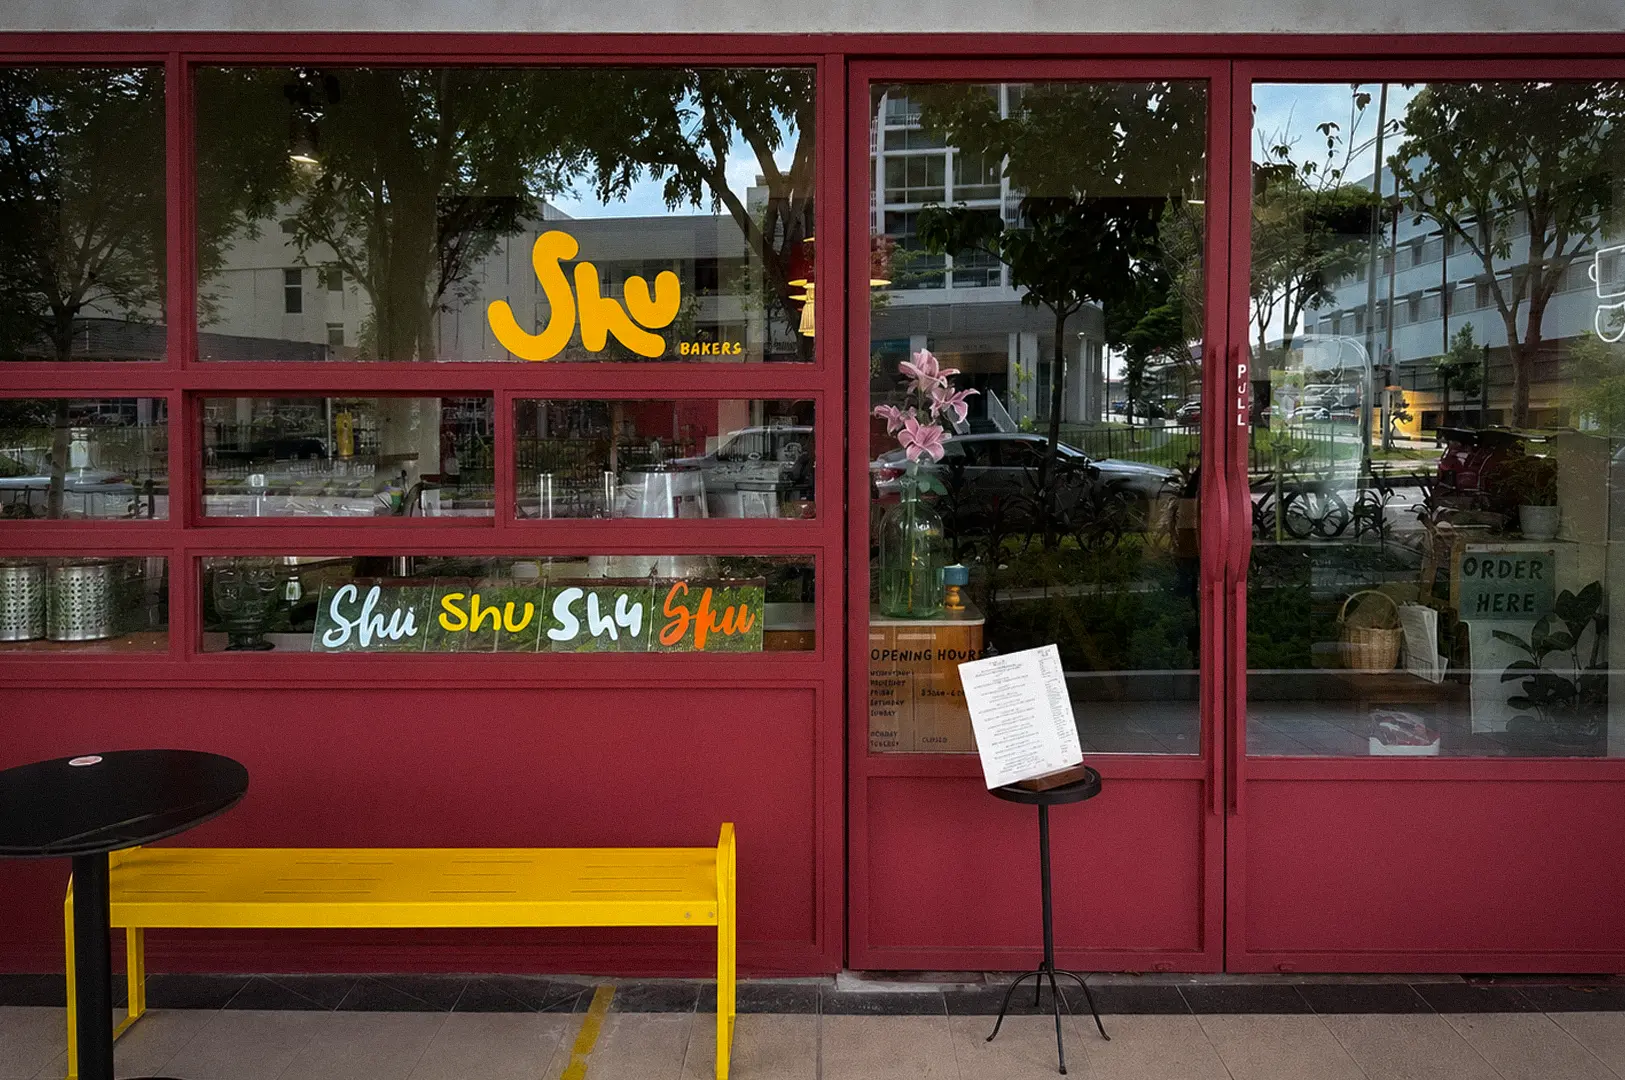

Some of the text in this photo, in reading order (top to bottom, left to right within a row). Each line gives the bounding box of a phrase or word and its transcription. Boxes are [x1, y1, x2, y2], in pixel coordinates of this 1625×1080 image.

[487, 230, 681, 361] Shu
[680, 342, 742, 355] BAKERS
[1237, 363, 1247, 426] PULL
[1463, 557, 1543, 579] ORDER
[1477, 593, 1535, 612] HERE
[322, 584, 418, 648] Shu
[659, 581, 756, 649] Shu
[870, 648, 932, 661] OPENING
